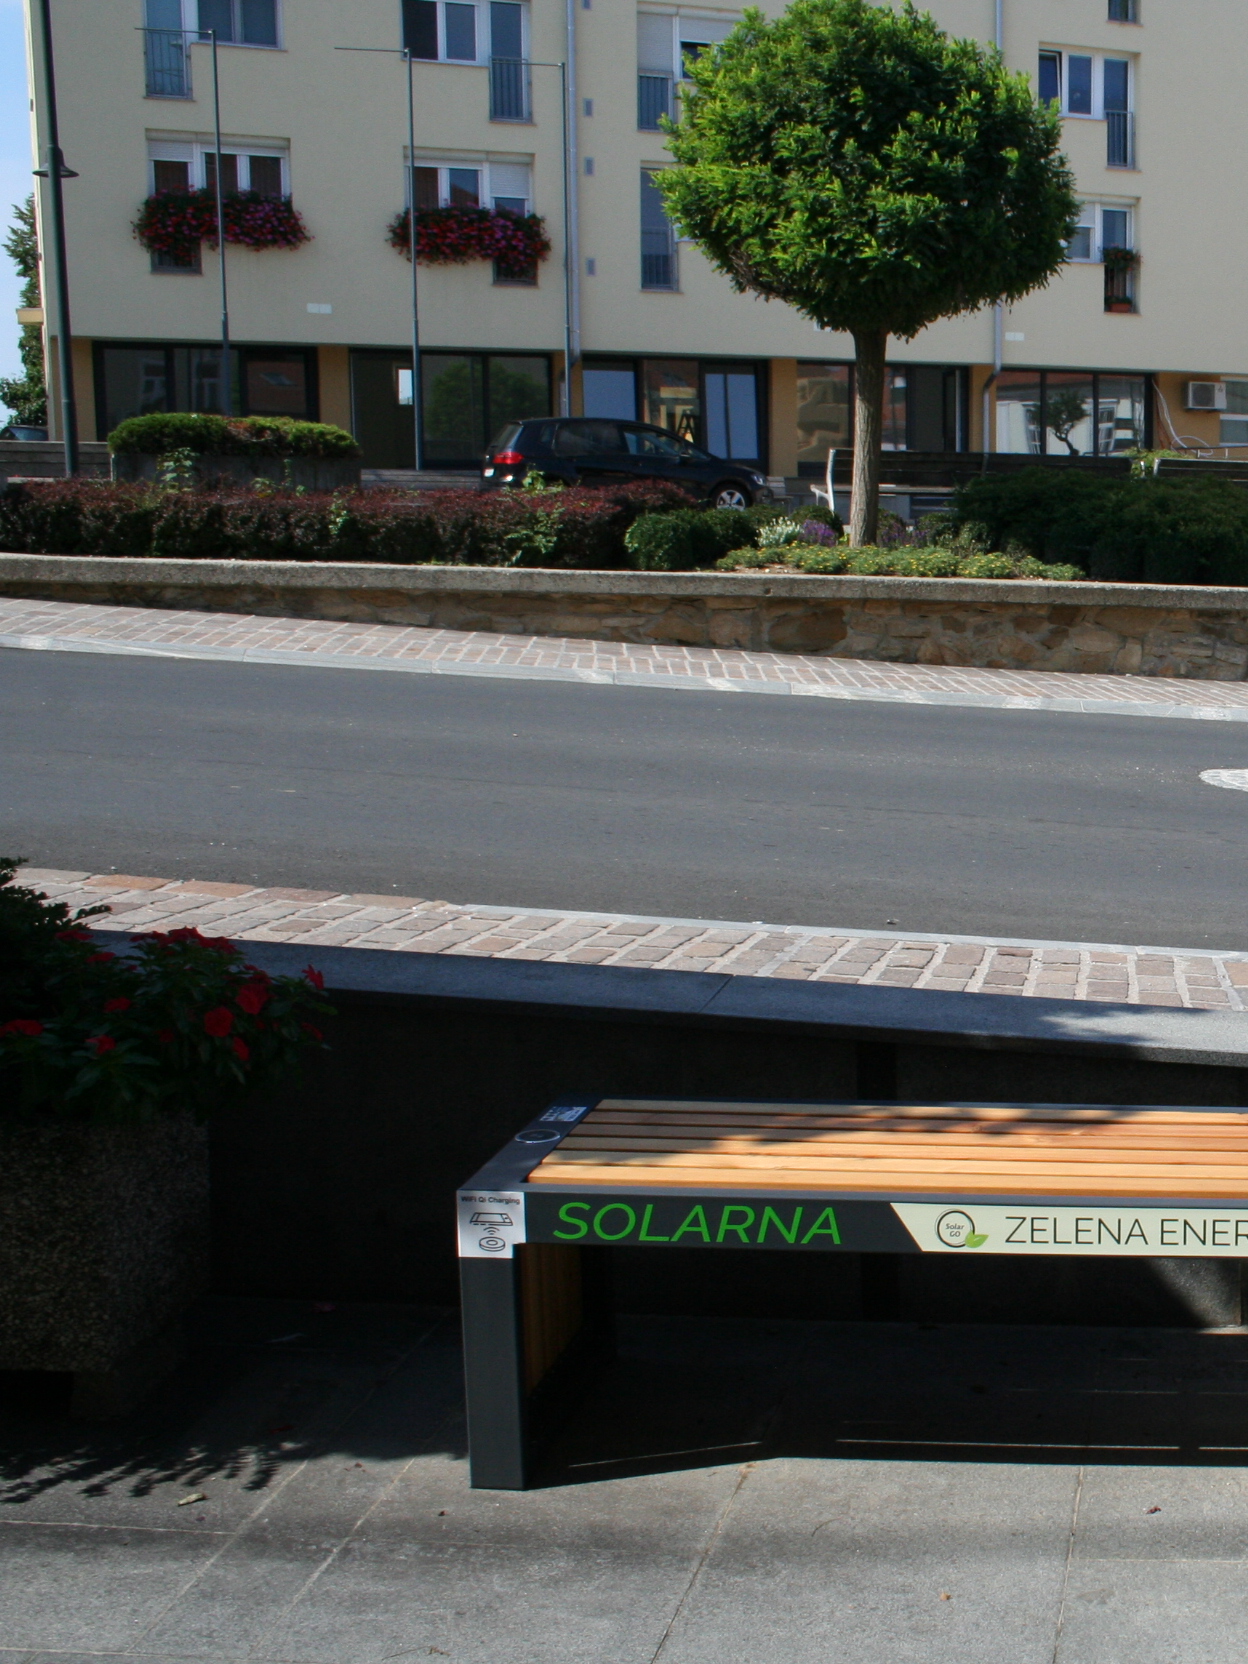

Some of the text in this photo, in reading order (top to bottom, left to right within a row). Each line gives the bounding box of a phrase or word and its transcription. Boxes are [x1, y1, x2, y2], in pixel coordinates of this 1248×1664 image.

[488, 1196, 521, 1205] Charging
[552, 1202, 841, 1245] SOLARNA
[1004, 1216, 1149, 1246] ZELENA
